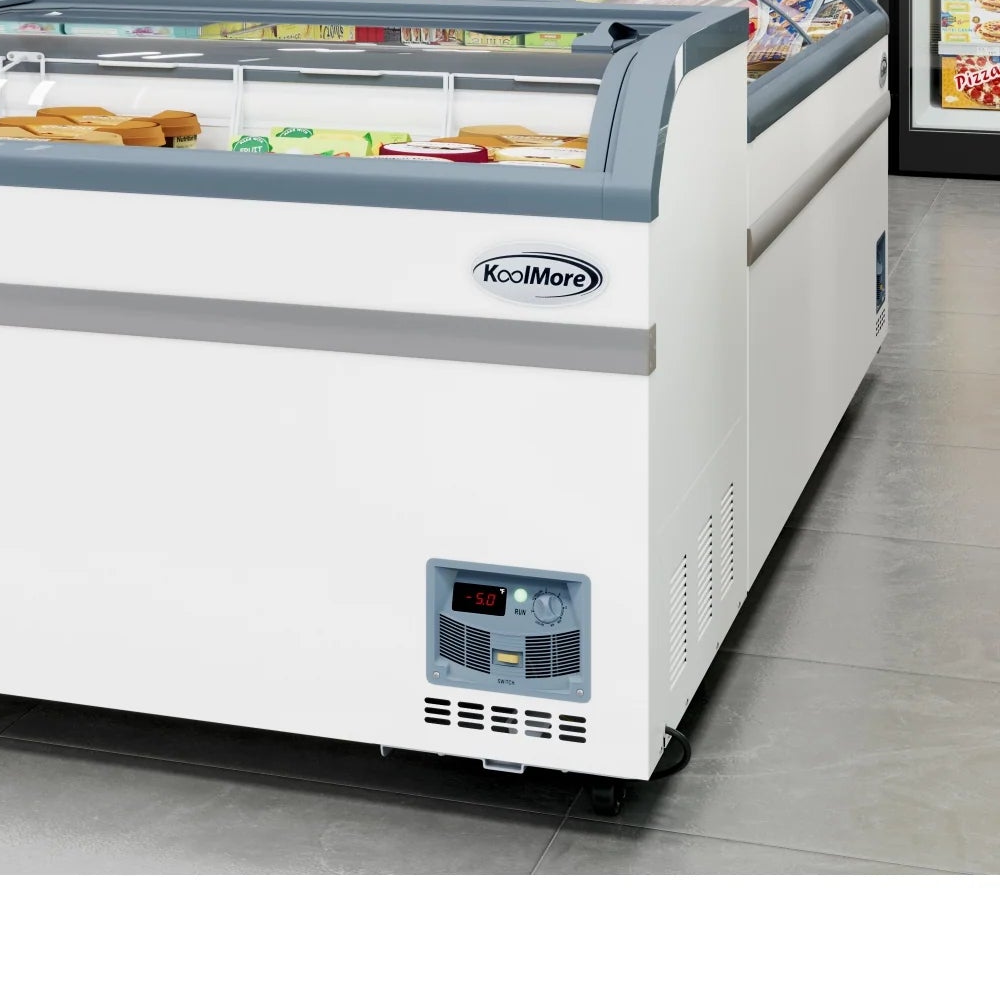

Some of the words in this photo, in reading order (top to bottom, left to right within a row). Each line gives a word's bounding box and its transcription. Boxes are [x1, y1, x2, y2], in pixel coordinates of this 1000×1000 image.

[483, 264, 586, 288] KoolMore
[514, 608, 526, 616] RUN
[498, 678, 515, 686] SWITCH
